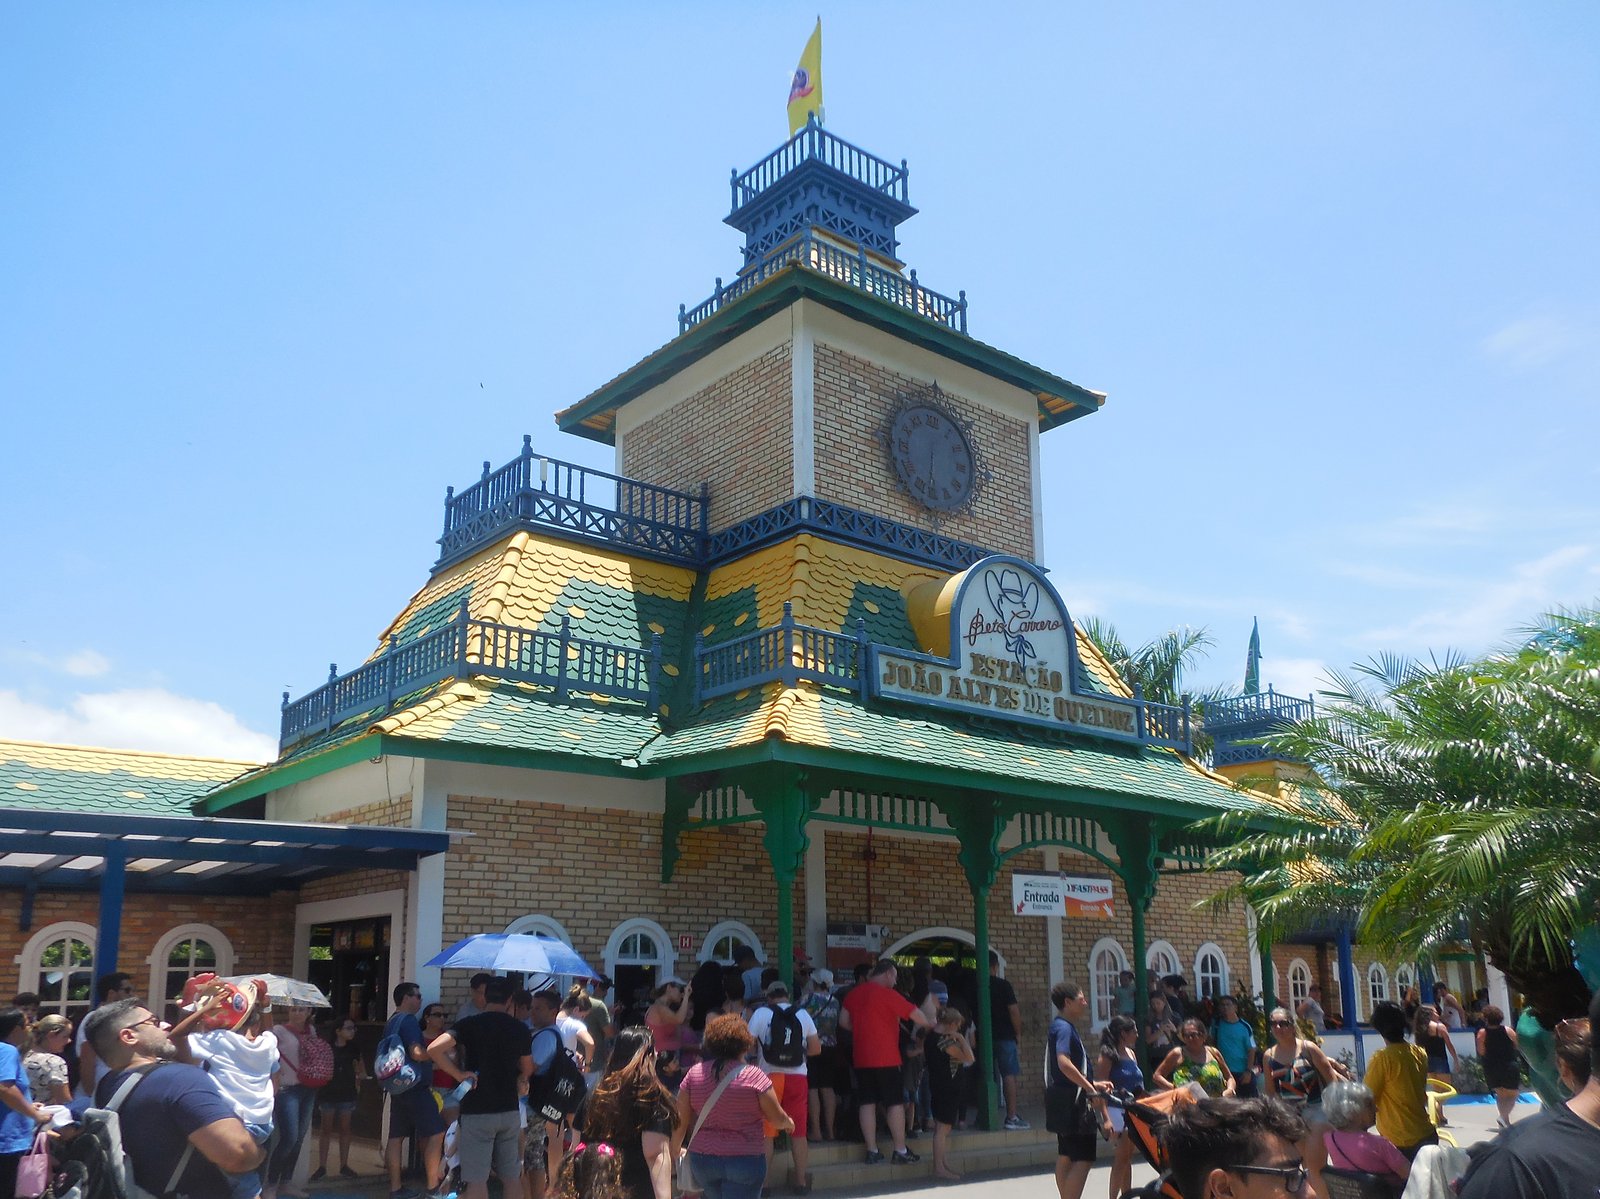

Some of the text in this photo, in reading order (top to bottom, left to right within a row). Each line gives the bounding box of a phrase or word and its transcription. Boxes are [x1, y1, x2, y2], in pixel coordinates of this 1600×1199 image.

[963, 608, 1062, 646] Beto Carrero
[883, 661, 943, 695] JOÃO
[946, 675, 1019, 709] ALVES
[1023, 689, 1050, 716] DE
[1024, 890, 1060, 903] Entrada
[682, 937, 690, 948] H
